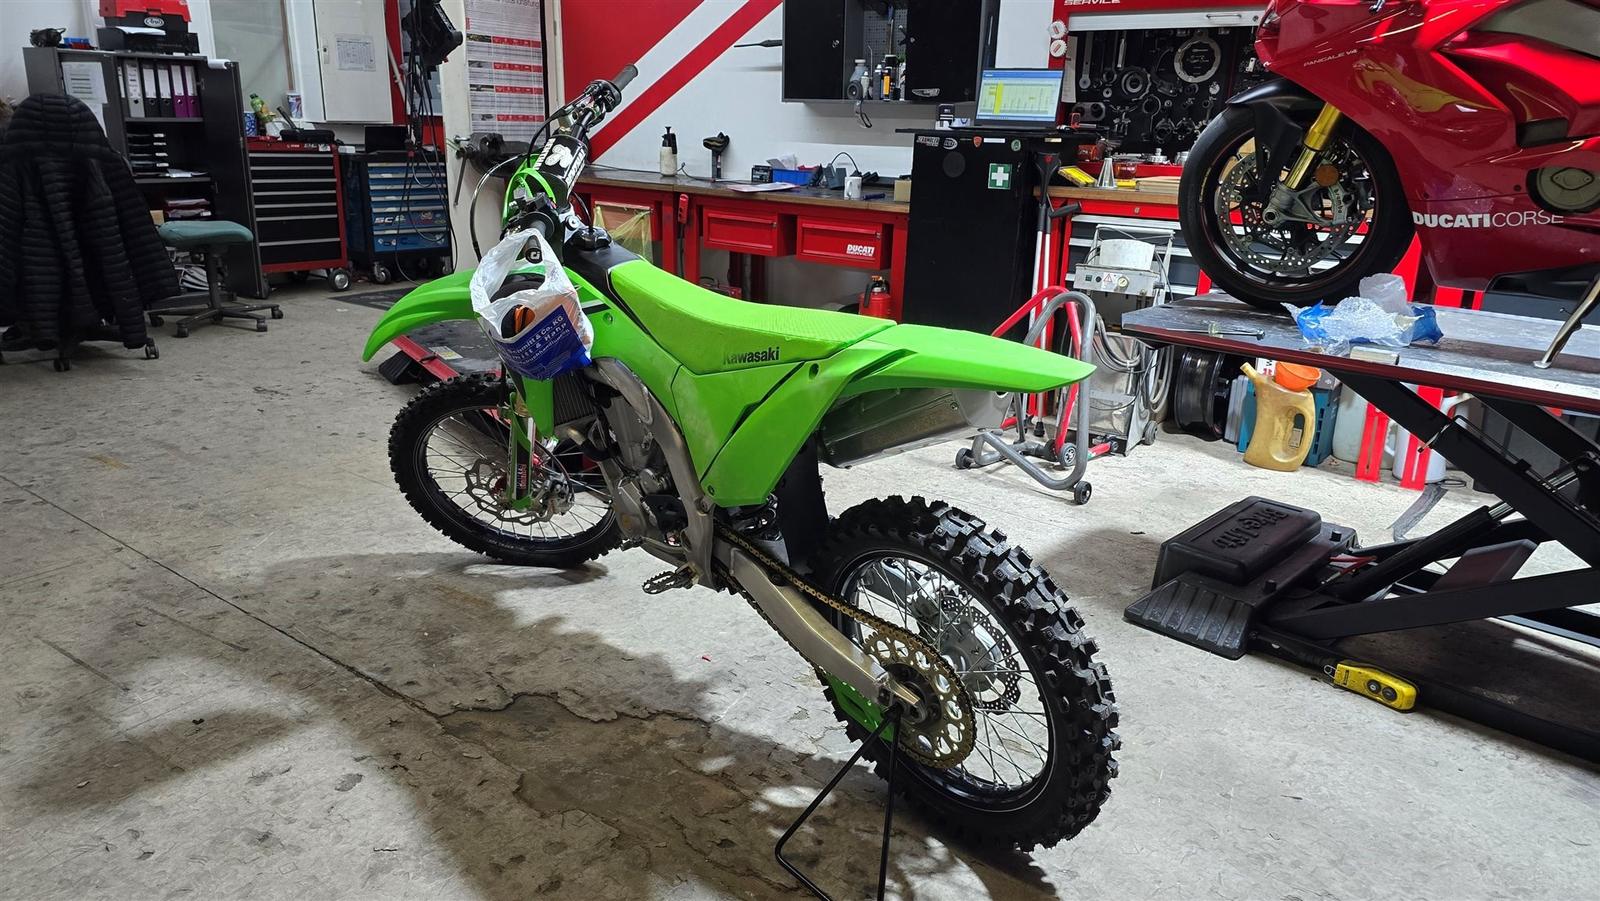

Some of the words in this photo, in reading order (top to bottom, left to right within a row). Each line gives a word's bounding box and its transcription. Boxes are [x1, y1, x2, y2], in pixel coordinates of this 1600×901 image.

[846, 243, 875, 254] DUCATI
[553, 315, 564, 326] KG
[722, 346, 780, 365] Kawasaki
